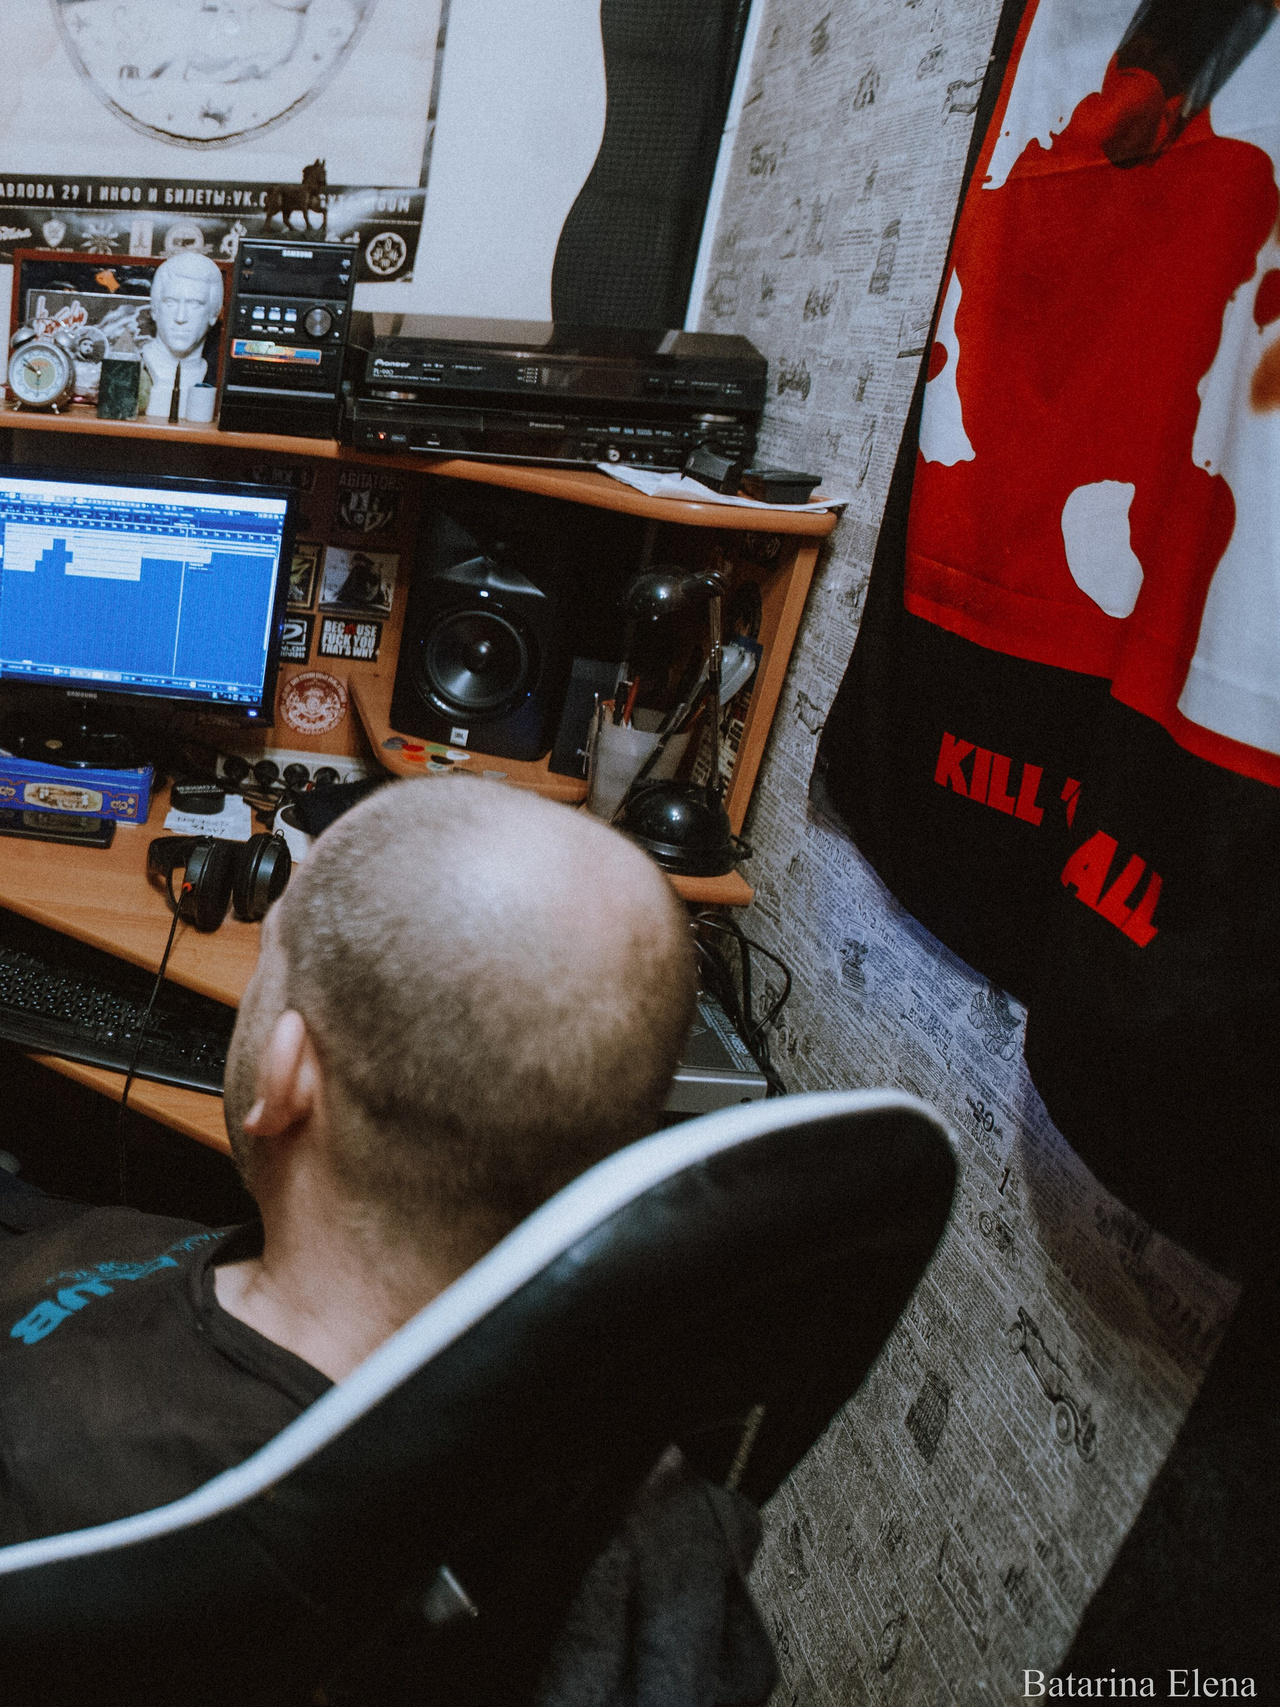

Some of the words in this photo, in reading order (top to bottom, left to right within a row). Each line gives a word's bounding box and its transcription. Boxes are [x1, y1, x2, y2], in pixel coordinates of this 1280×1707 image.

[62, 184, 79, 200] 29
[148, 187, 158, 203] И
[373, 358, 411, 368] Pioneer
[322, 632, 351, 647] FUCK
[353, 634, 376, 649] YOU
[352, 647, 375, 659] WHY
[934, 731, 1044, 827] KILL
[1061, 830, 1163, 948] ALL
